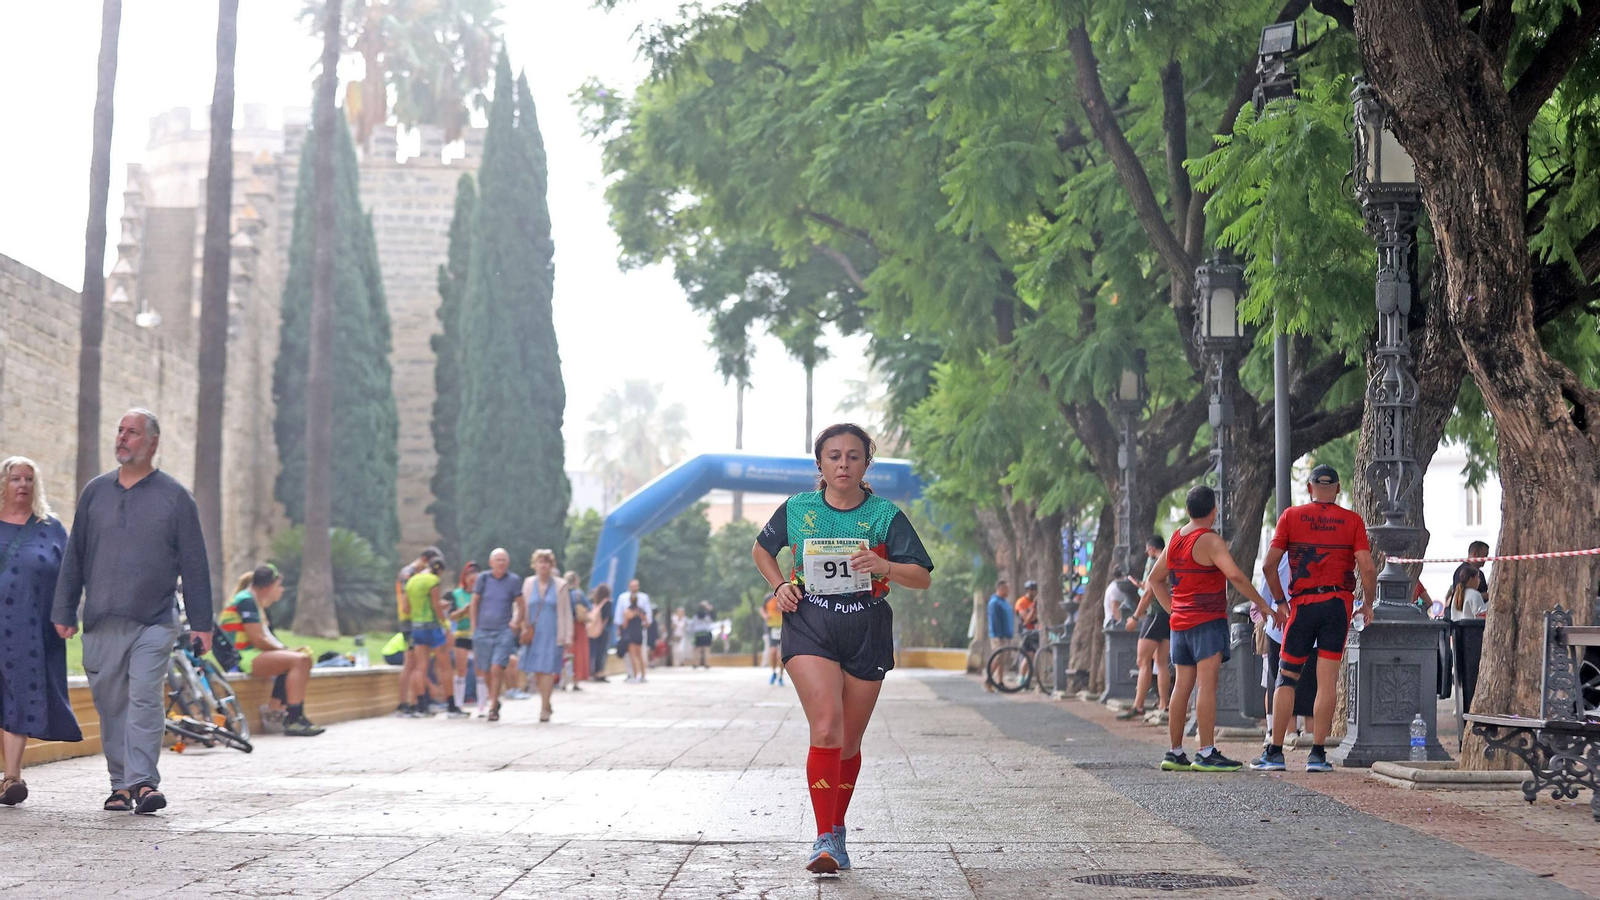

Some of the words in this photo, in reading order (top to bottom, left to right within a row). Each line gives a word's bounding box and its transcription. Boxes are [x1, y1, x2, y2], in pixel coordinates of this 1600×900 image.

[823, 561, 852, 579] 91
[804, 593, 829, 609] PUMA
[834, 602, 864, 613] PUMA
